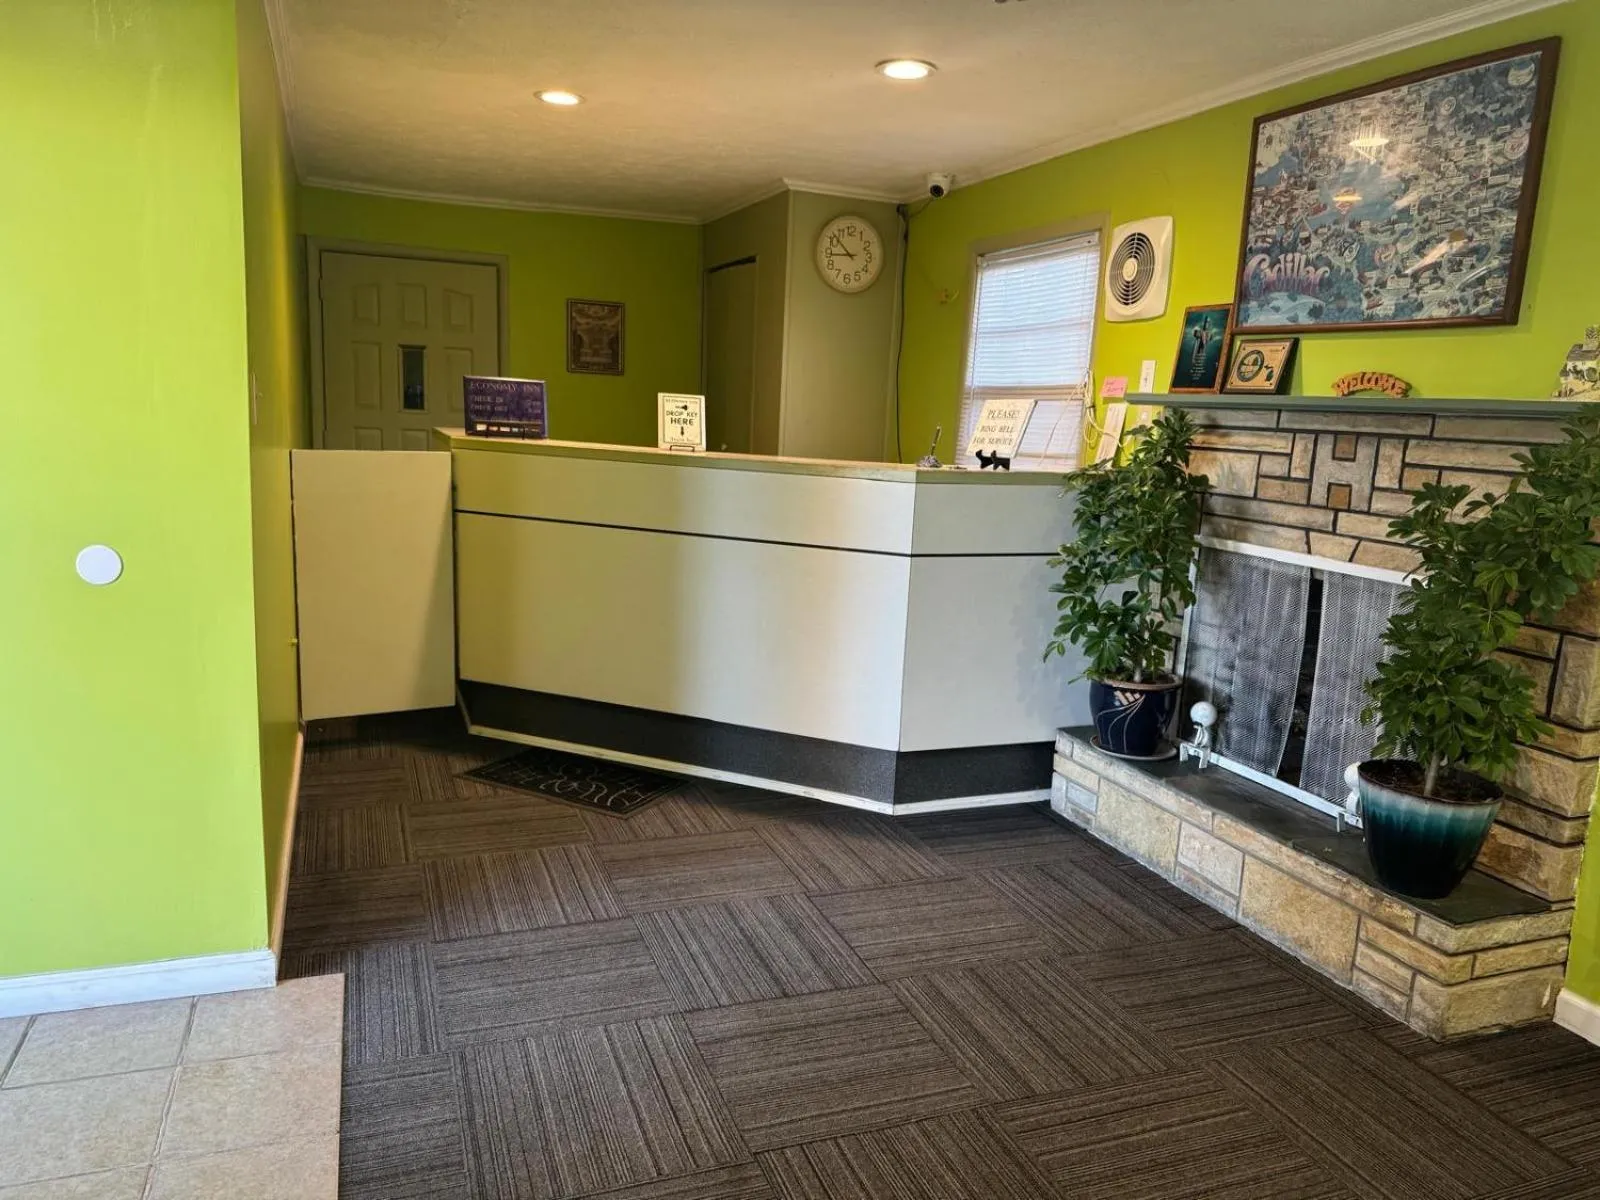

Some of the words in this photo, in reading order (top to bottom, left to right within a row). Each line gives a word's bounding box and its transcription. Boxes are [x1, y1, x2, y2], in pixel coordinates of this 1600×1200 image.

[837, 229, 845, 239] 11
[846, 225, 857, 237] 12
[858, 230, 864, 241] 1
[829, 234, 840, 248] 10
[863, 240, 871, 252] 2
[824, 247, 833, 259] 9
[865, 252, 873, 264] 3
[826, 259, 834, 271] 8
[861, 264, 868, 273] 4
[834, 268, 842, 279] 7
[842, 273, 851, 285] 6
[853, 271, 861, 282] 5
[1245, 252, 1331, 297] Cadillac
[470, 382, 517, 393] ECONOMY
[523, 383, 541, 394] INN
[670, 417, 694, 426] HERE
[980, 424, 997, 433] RING
[998, 424, 1015, 433] BELL
[973, 436, 986, 445] FOR
[987, 436, 1014, 446] SERVICE
